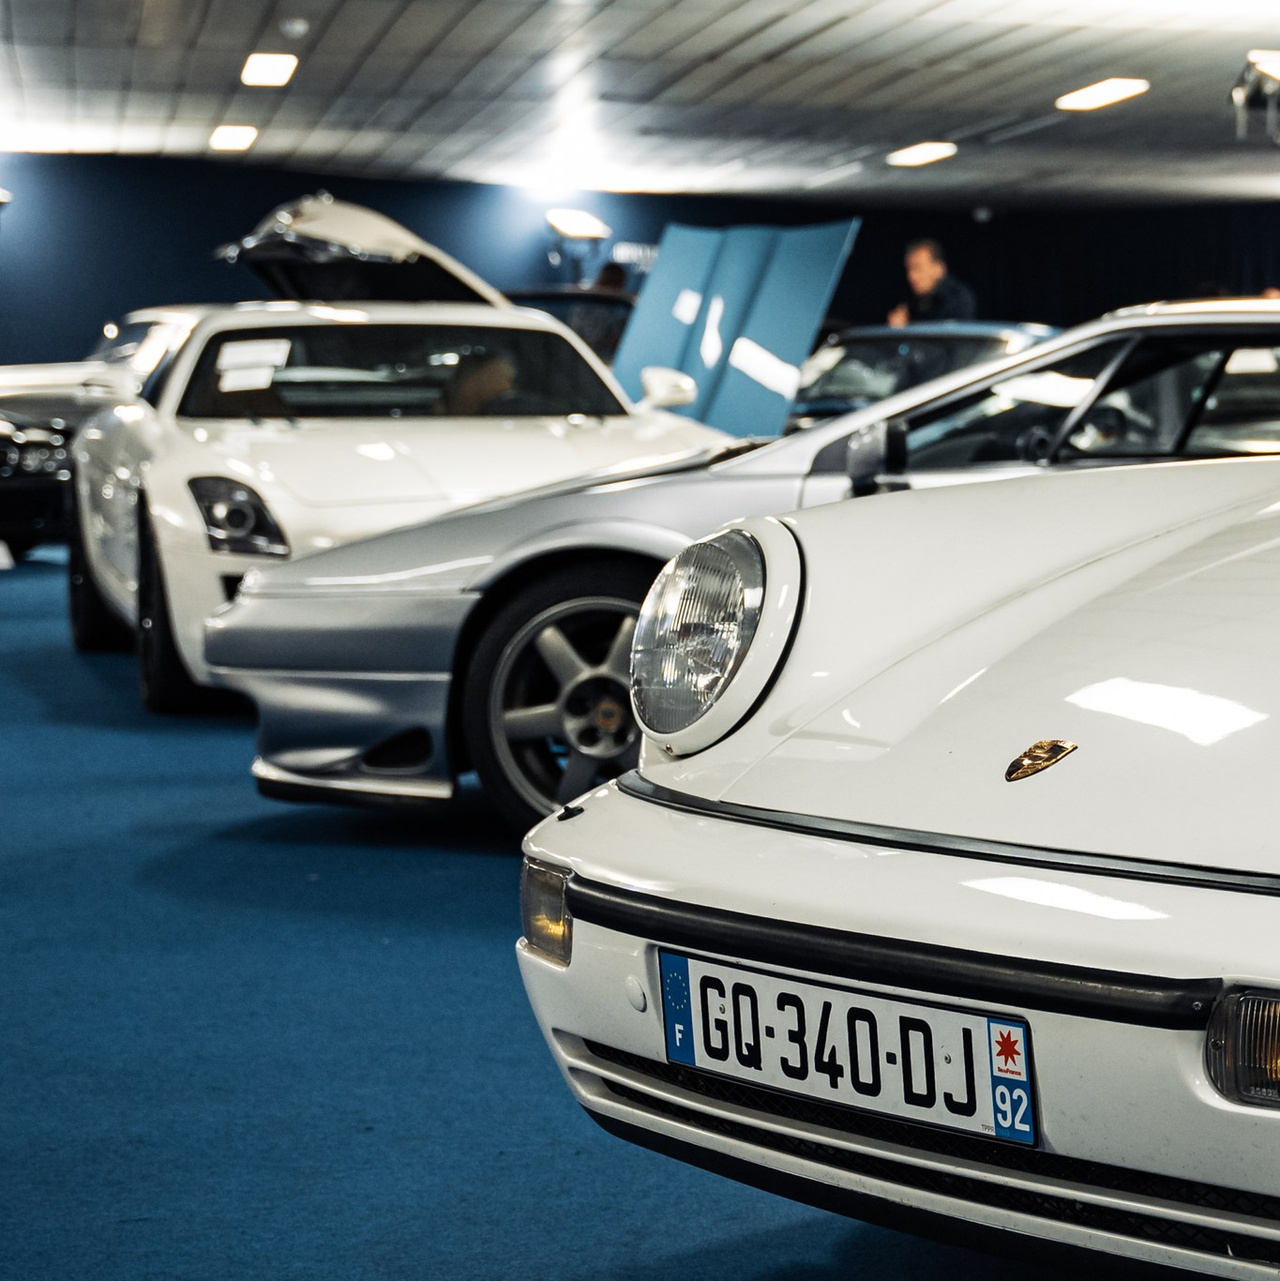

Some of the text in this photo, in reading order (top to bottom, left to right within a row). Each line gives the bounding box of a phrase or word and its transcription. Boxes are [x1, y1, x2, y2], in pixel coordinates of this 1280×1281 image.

[675, 1023, 684, 1048] F
[699, 974, 977, 1118] GQ-340-DJ
[995, 1084, 1031, 1132] 92
